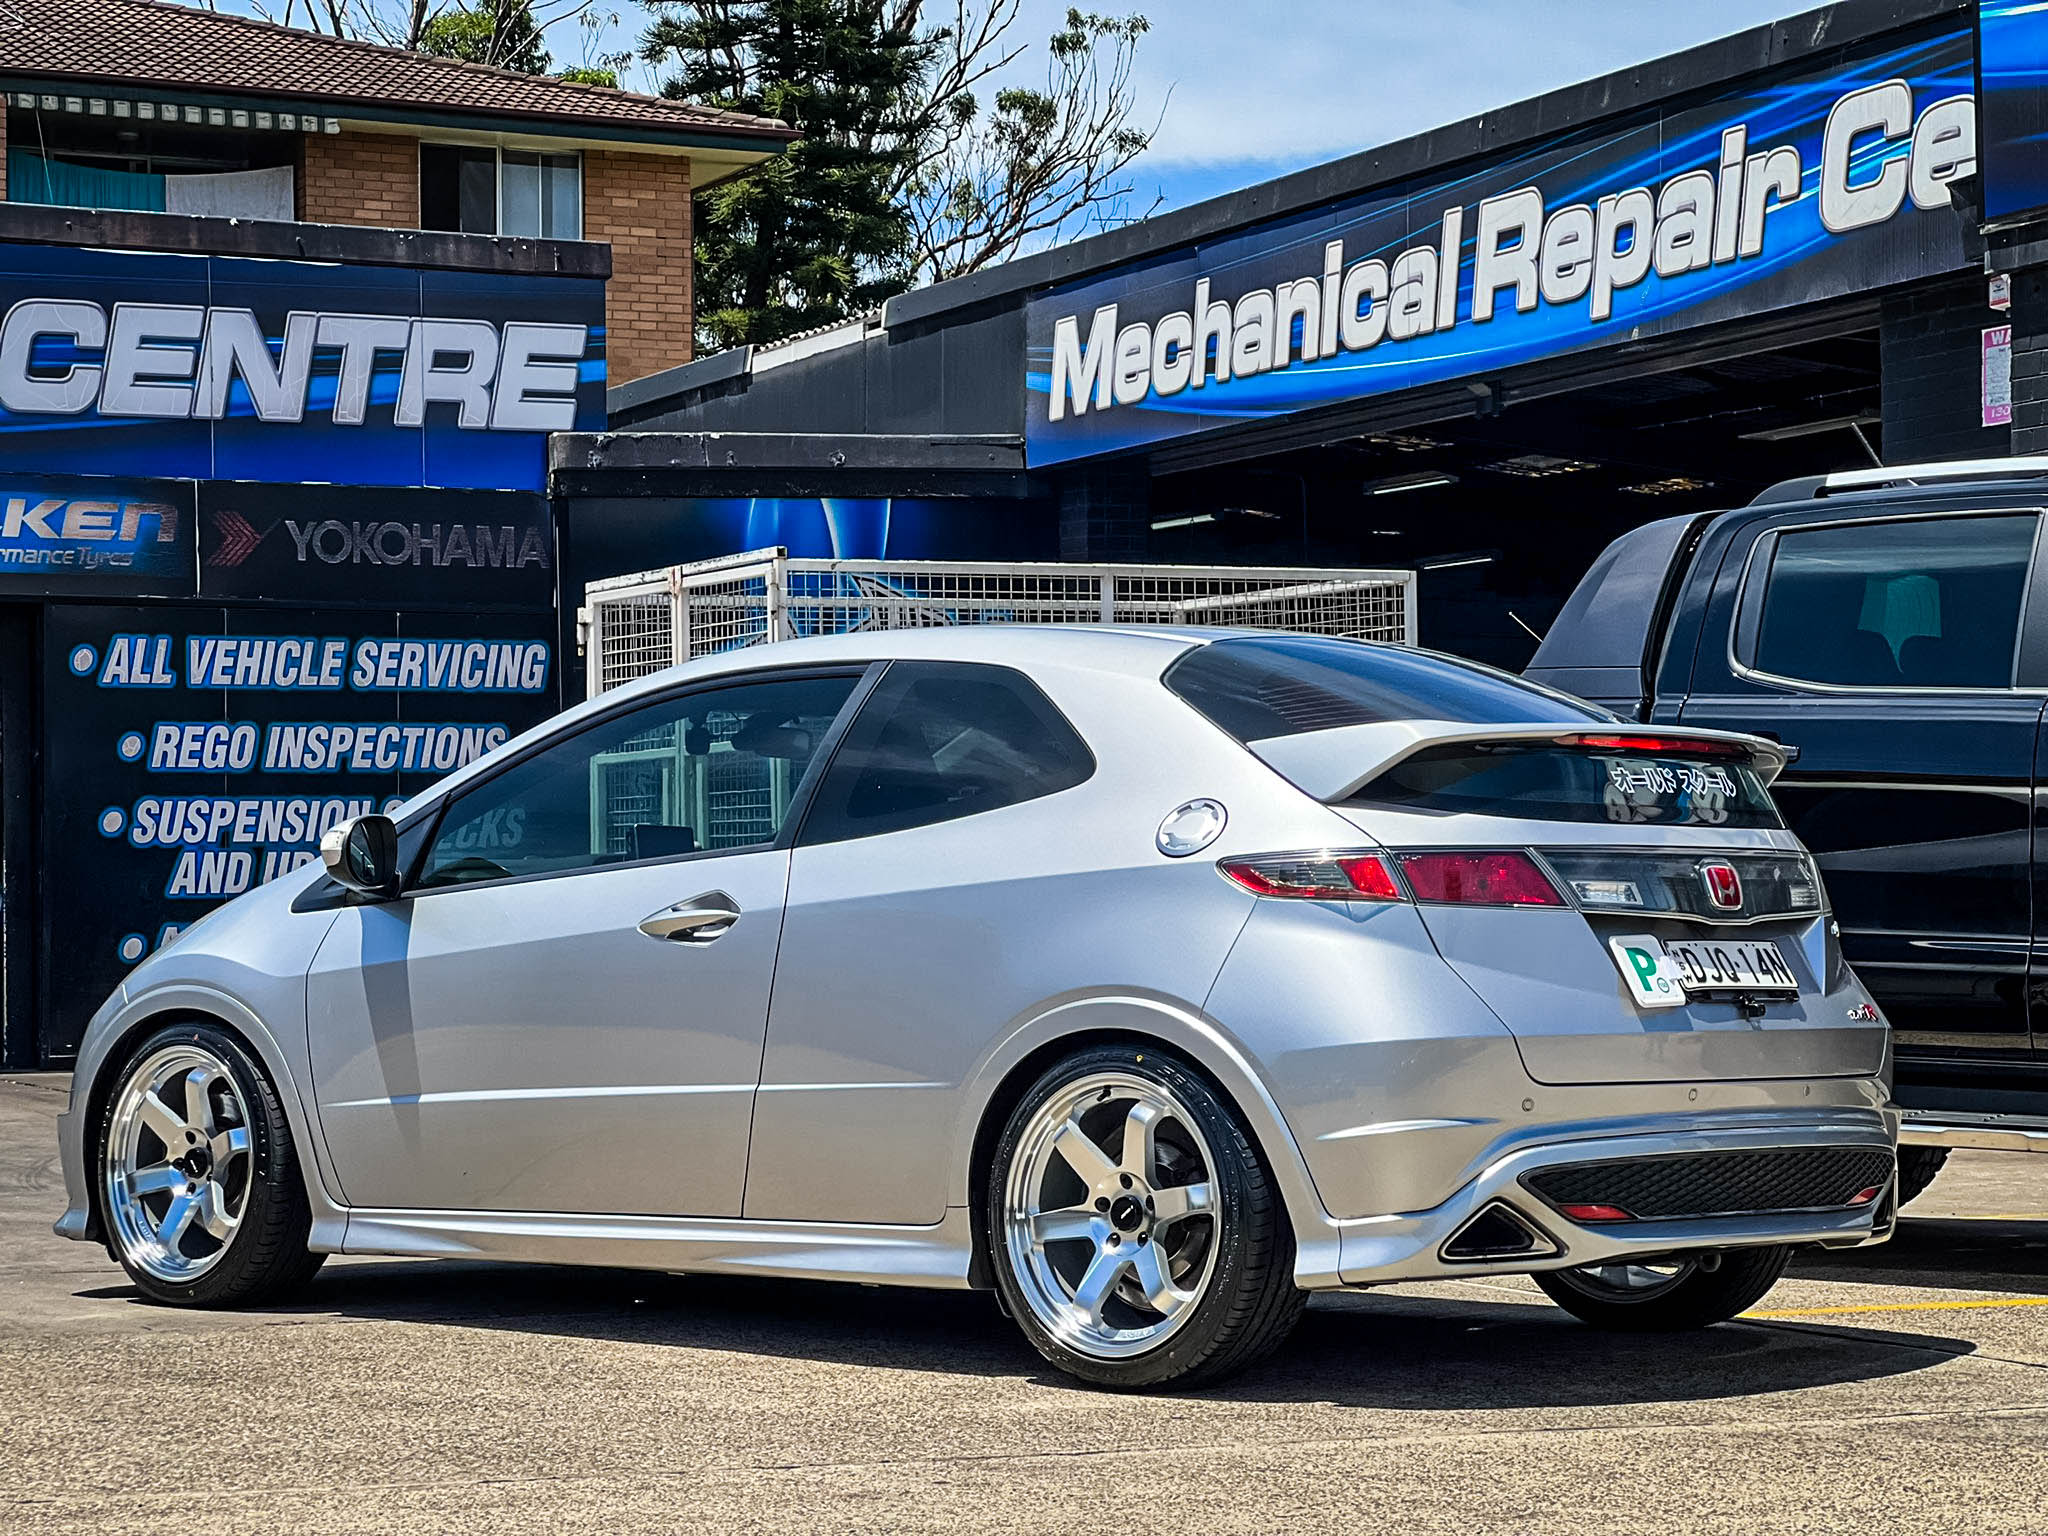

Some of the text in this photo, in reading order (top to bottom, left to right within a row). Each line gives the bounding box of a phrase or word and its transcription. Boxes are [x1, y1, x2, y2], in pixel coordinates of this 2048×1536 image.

[1049, 206, 1463, 422] Mechanical
[1472, 125, 1801, 322] Repair
[0, 298, 587, 431] CENTRE
[285, 519, 549, 568] YOKOHAMA
[102, 637, 547, 690] ALL VEHICLE SERVICING
[151, 725, 256, 769] REGO
[169, 851, 251, 894] AND
[1625, 947, 1658, 992] P
